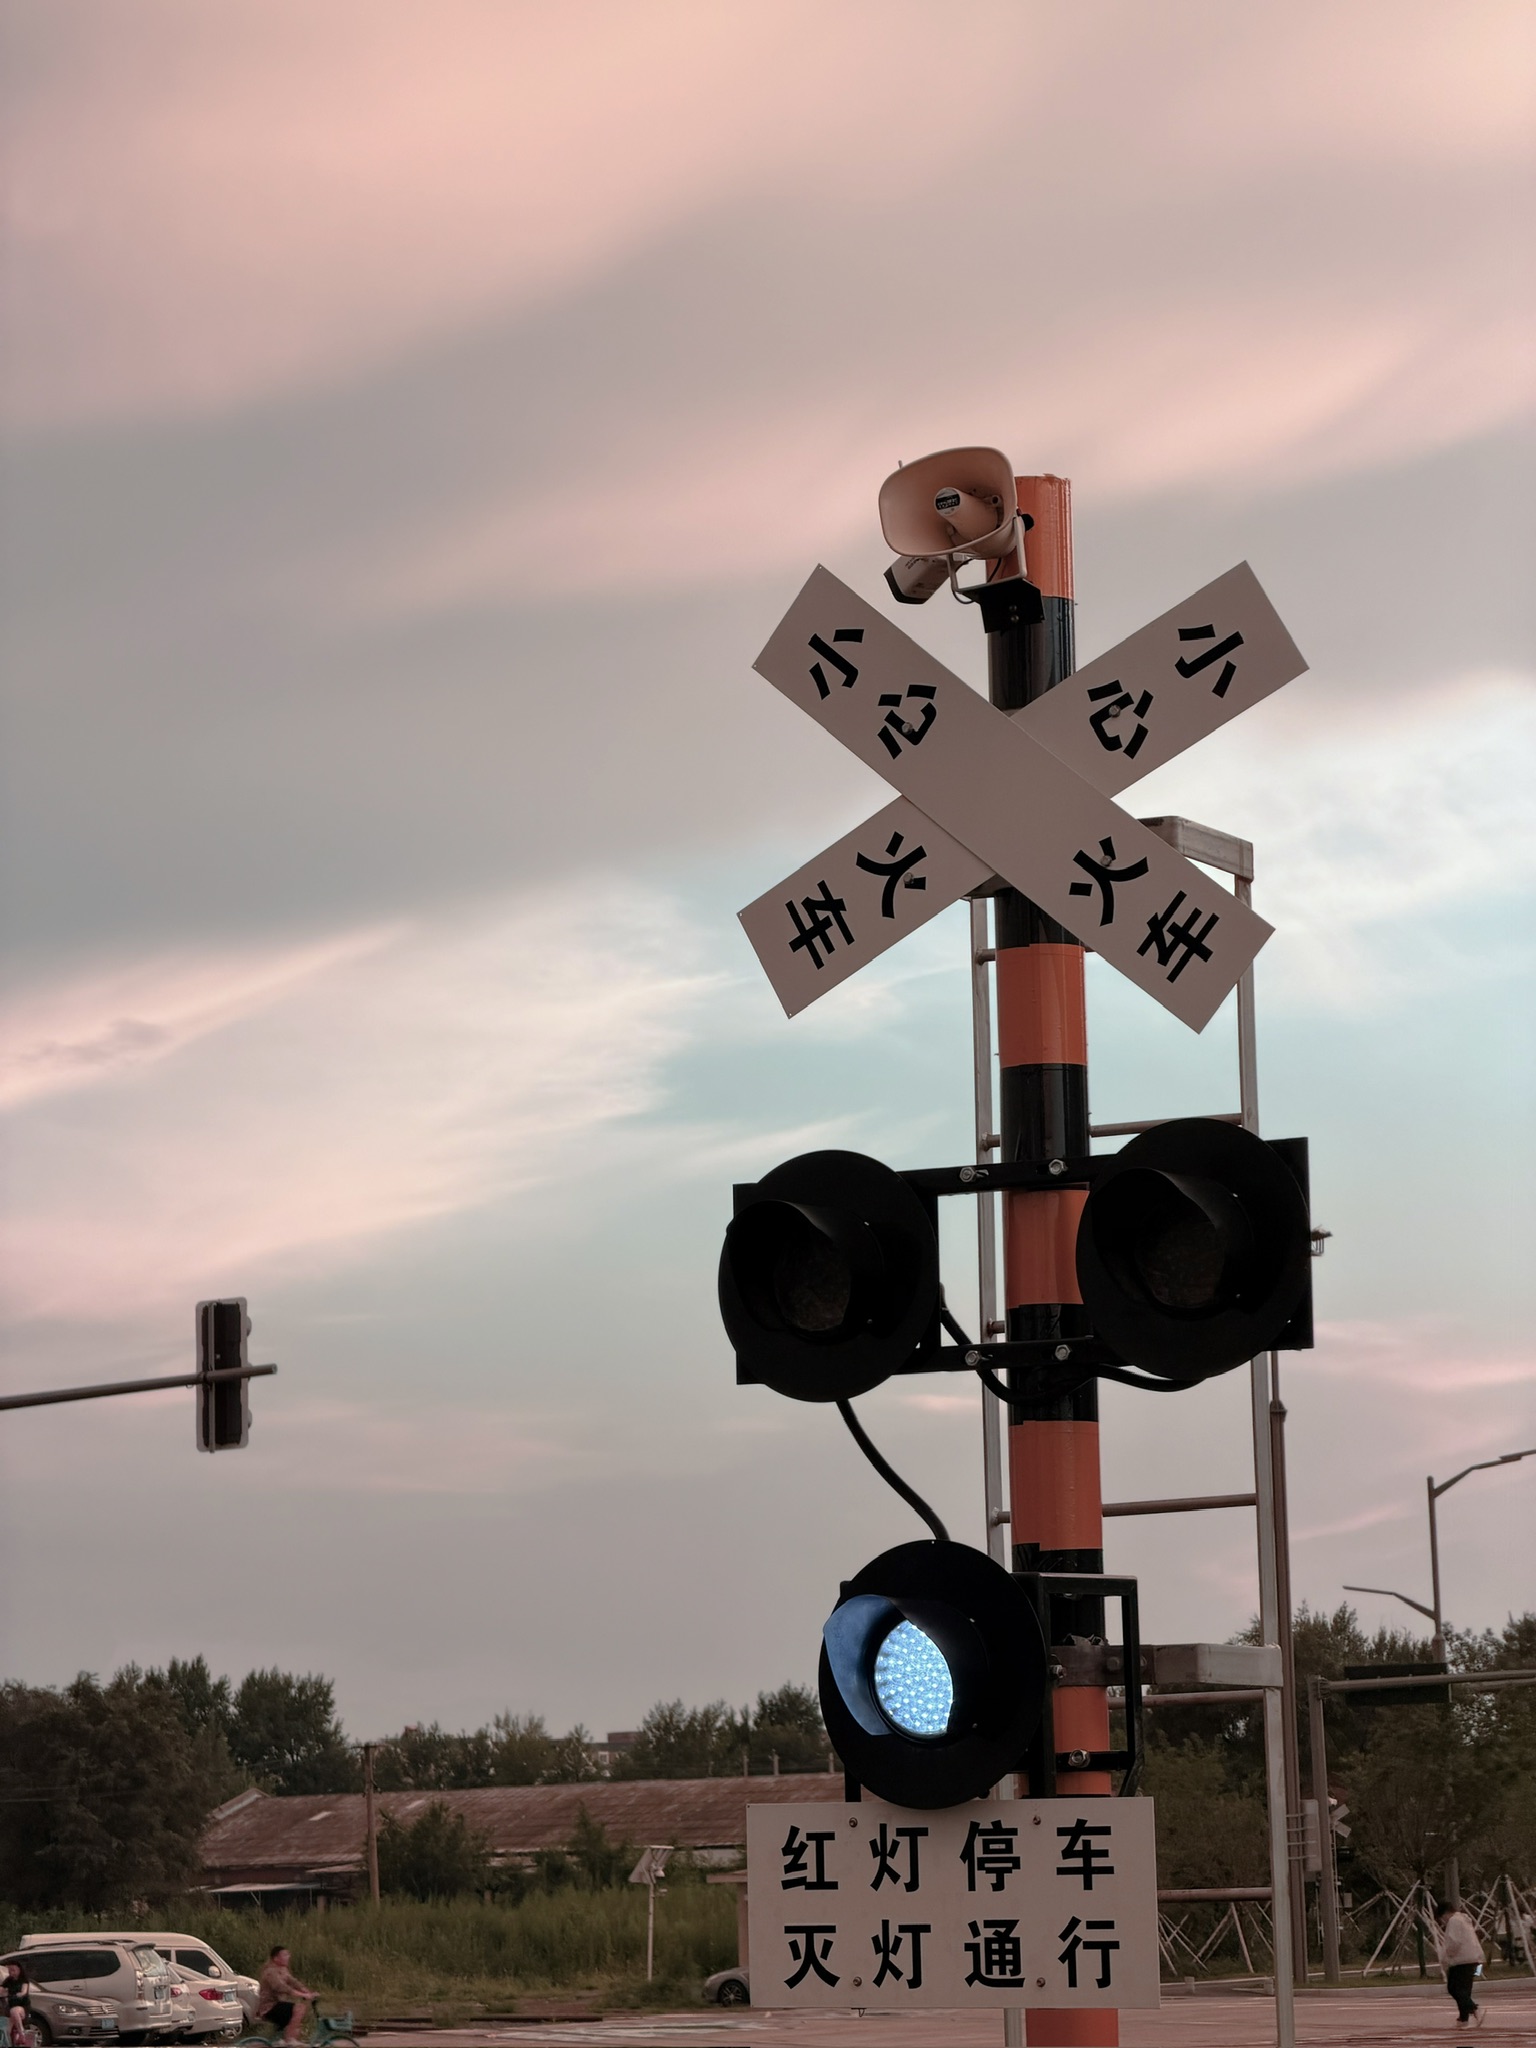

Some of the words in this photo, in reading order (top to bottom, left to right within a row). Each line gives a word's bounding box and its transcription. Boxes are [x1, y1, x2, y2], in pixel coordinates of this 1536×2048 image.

[781, 1818, 1115, 1892] 红灯停车
[784, 1916, 1120, 1989] 灭灯通行
